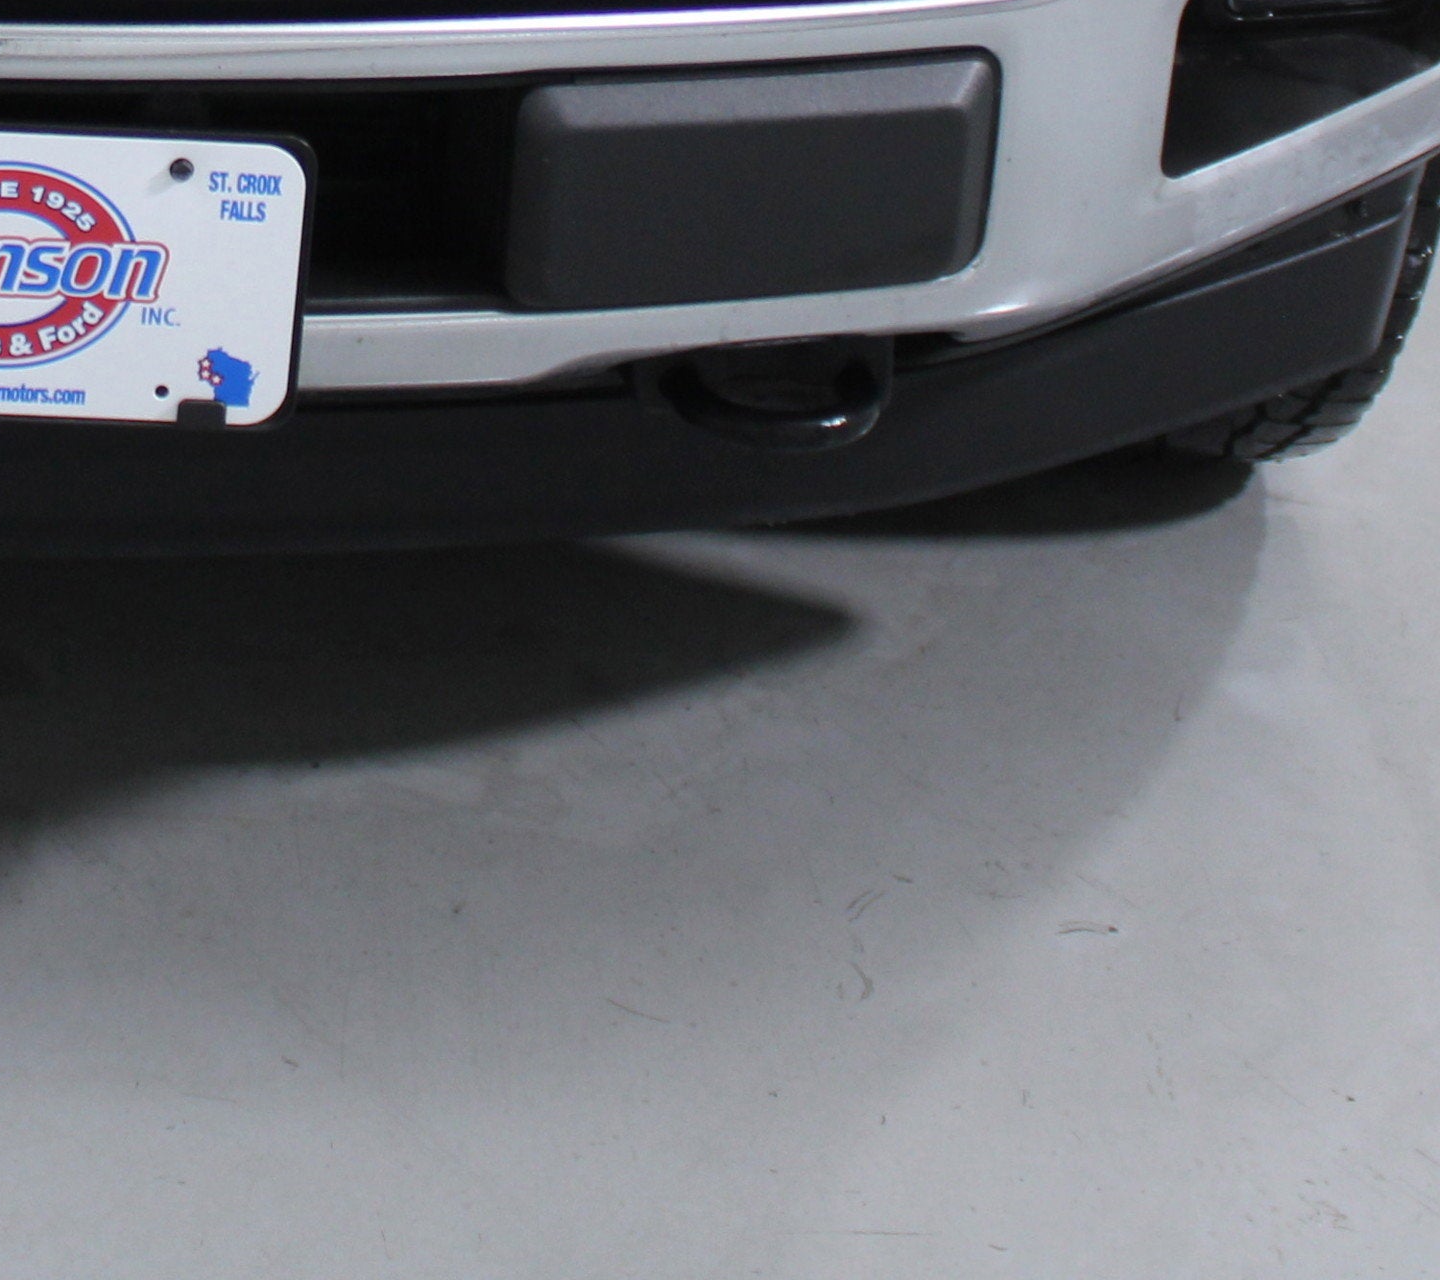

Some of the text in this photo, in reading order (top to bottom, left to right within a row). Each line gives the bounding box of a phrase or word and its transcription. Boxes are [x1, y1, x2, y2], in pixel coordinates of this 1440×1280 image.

[208, 171, 282, 196] ST. CROIX
[31, 186, 97, 233] 1925
[219, 199, 267, 222] FALLS
[8, 333, 34, 357] &
[37, 302, 105, 351] Ford
[140, 307, 181, 327] INC.
